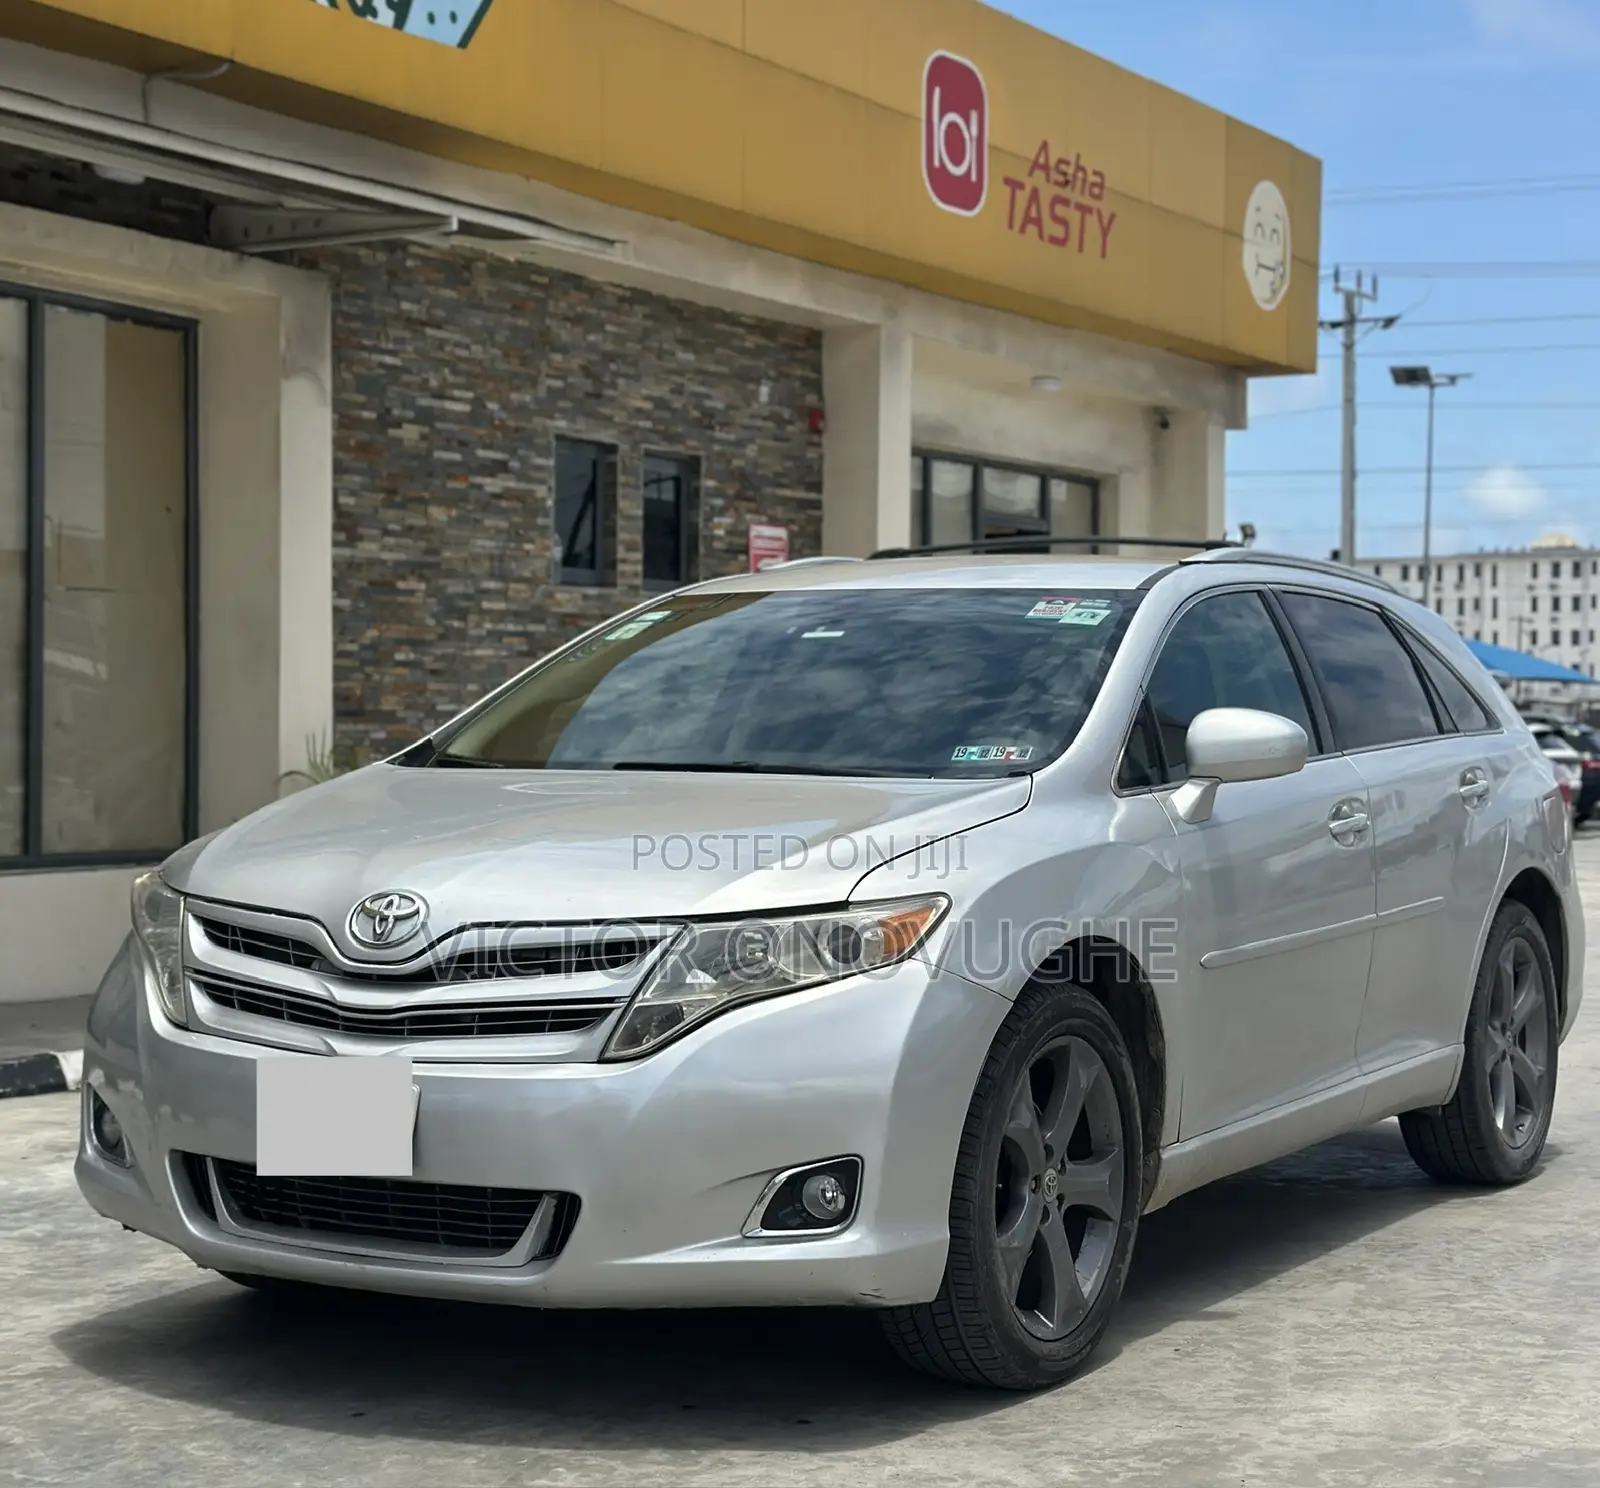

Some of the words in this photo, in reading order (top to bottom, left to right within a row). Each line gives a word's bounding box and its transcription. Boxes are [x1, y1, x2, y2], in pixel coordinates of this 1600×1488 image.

[1027, 139, 1106, 201] Asha
[1002, 176, 1117, 260] TASTY
[954, 747, 968, 758] 19
[993, 746, 1007, 758] 19
